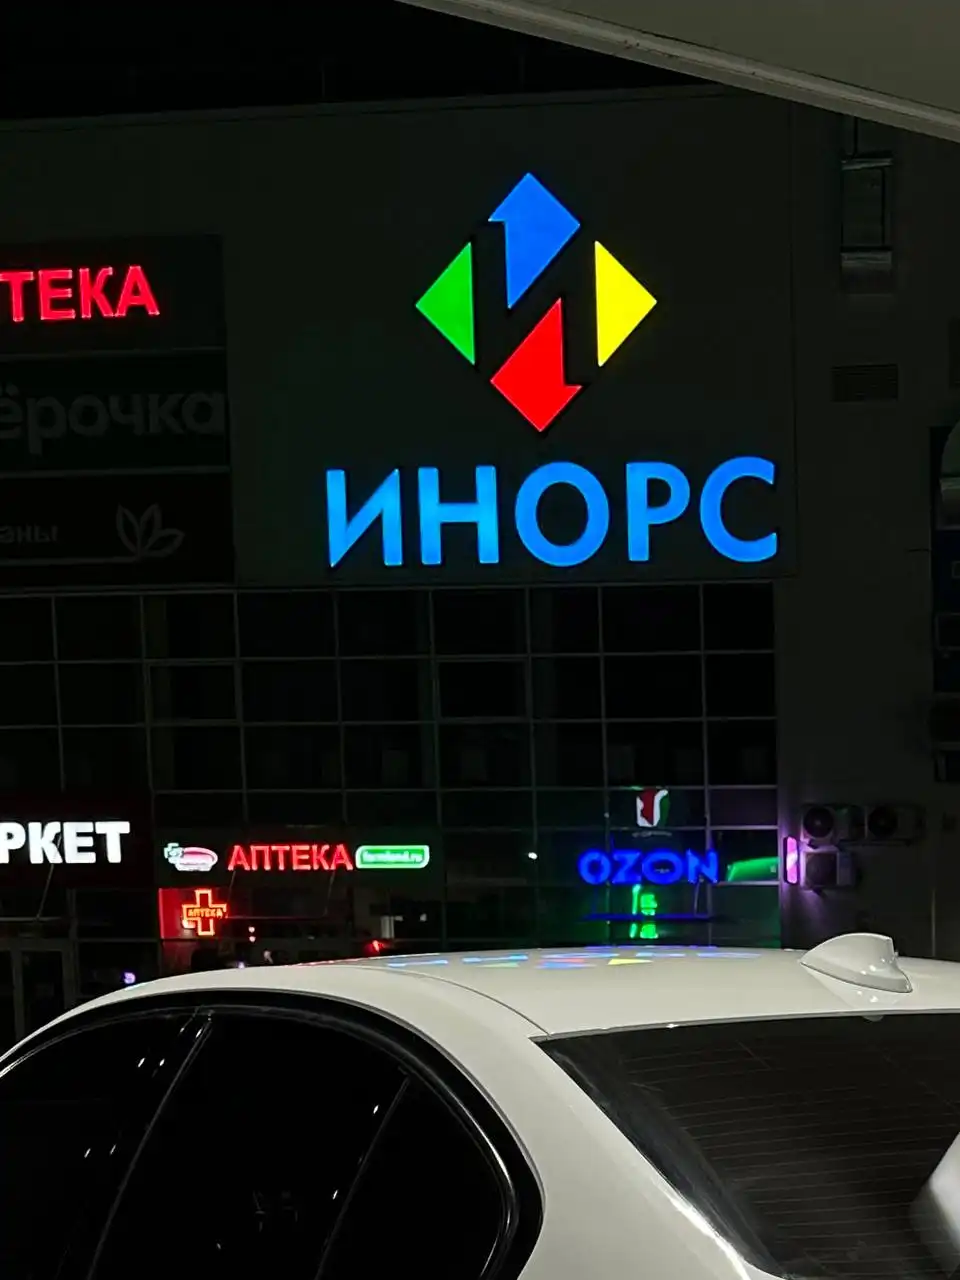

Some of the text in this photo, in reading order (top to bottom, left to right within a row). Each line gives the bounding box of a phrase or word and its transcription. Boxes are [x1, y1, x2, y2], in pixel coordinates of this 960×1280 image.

[325, 456, 779, 568] ИНОРС
[0, 820, 131, 865] РКЕТ
[227, 843, 355, 871] АПТЕКА
[577, 848, 719, 885] OZON
[188, 907, 223, 919] АПТЕКА
